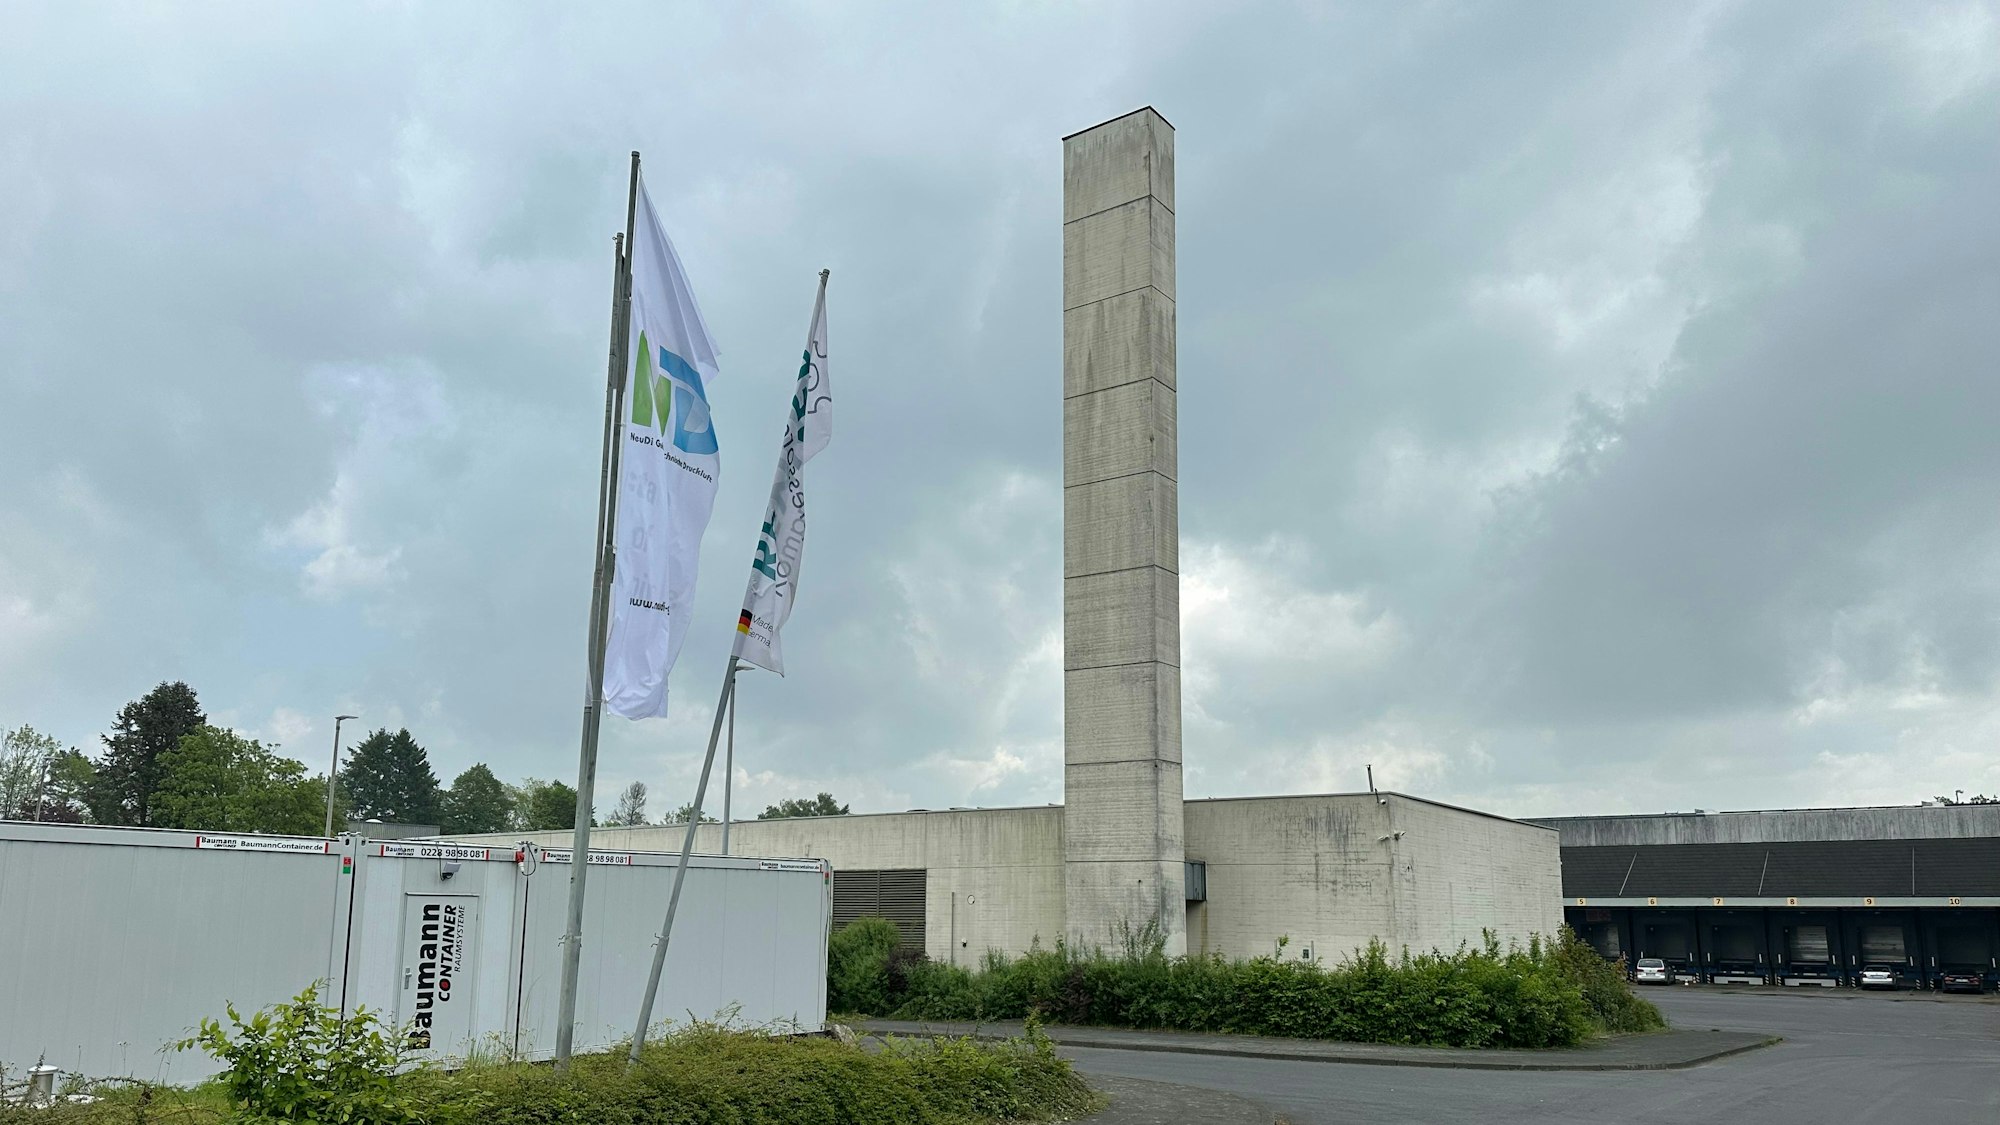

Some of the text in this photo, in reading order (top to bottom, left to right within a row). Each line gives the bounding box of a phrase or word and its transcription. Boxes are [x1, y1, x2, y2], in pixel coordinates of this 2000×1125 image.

[630, 432, 654, 446] NeuDi
[682, 461, 713, 484] Druckluft
[201, 836, 237, 845] Baumann
[240, 841, 323, 851] BaumannContainer.de
[385, 846, 415, 854] Baumann
[420, 846, 443, 857] 0228
[445, 847, 456, 857] 98
[457, 847, 468, 858] 98
[469, 848, 485, 858] 081
[595, 855, 605, 863] 98
[605, 855, 614, 863] 98
[615, 856, 628, 864] 081
[453, 904, 466, 973] RAUMSYSTEME
[438, 904, 457, 1002] CONTAINER
[408, 904, 440, 1050] Baumann
